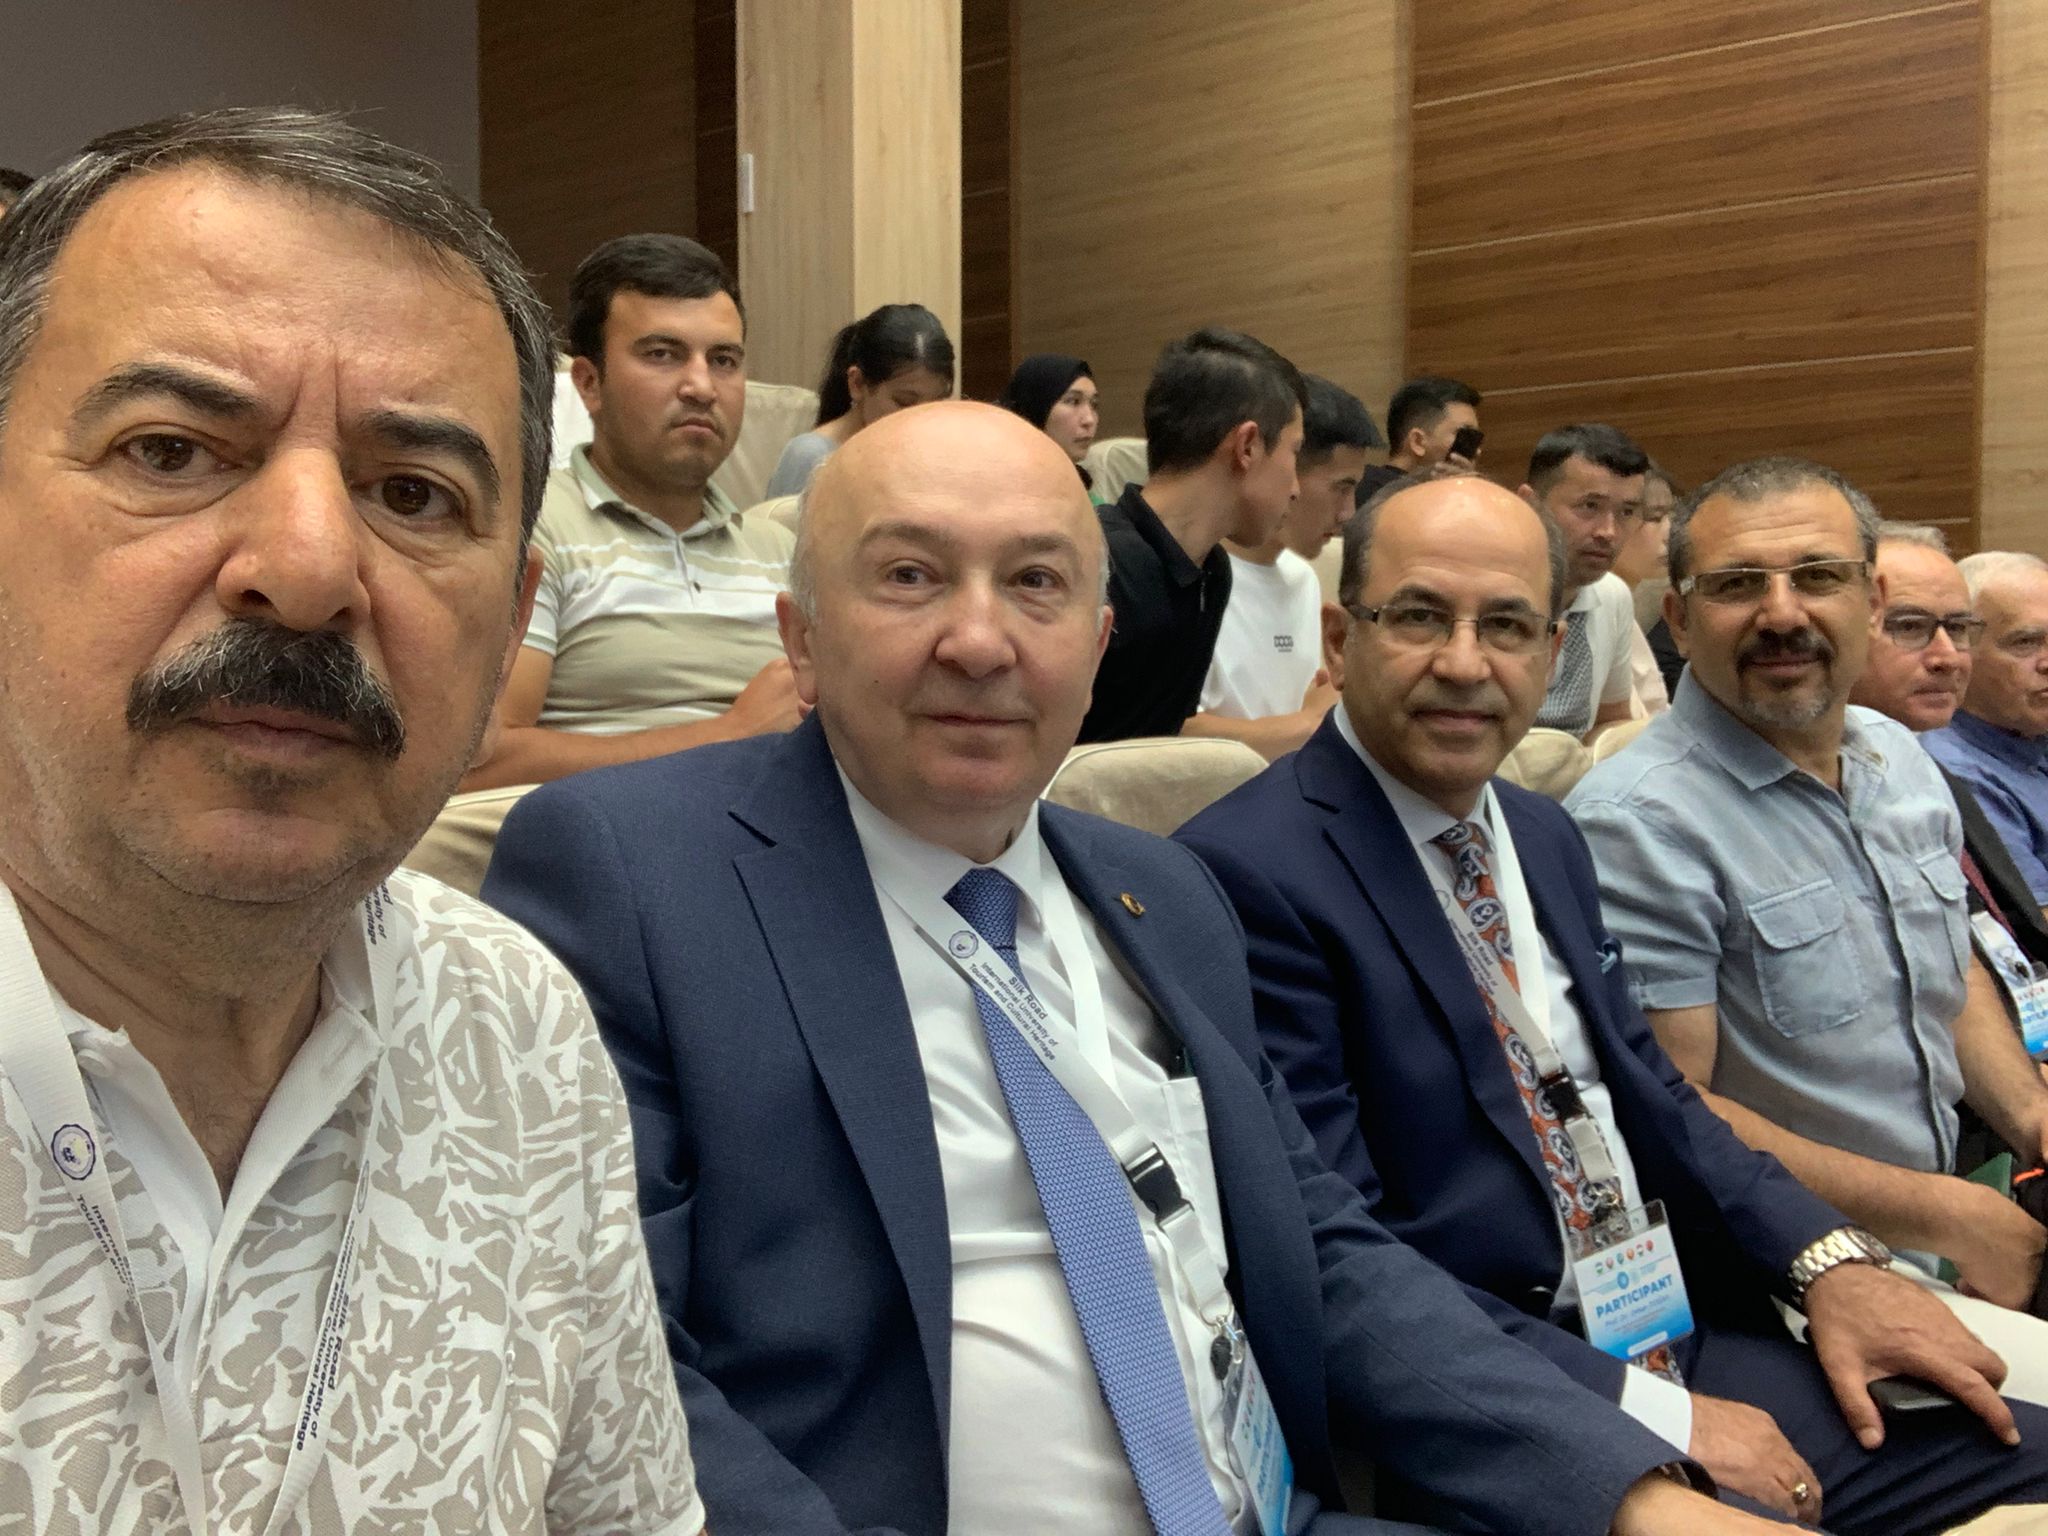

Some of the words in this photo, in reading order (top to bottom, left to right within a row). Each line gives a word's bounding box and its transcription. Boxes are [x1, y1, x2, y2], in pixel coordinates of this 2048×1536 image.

[378, 924, 387, 939] of
[969, 963, 996, 990] Tourism
[994, 989, 1008, 1003] and
[1006, 1002, 1032, 1031] Cultural
[1030, 1030, 1056, 1060] Heritage
[981, 962, 1020, 1004] International
[1019, 1002, 1050, 1039] University
[1048, 1038, 1059, 1047] of
[1008, 976, 1026, 995] Silk
[1024, 994, 1048, 1020] Road
[77, 1194, 110, 1253] Tourism
[329, 1281, 339, 1313] and
[337, 1293, 350, 1330] Silk
[1596, 1274, 1672, 1318] PARTICIPANT
[312, 1315, 331, 1379] Cultural
[328, 1336, 343, 1390] Road
[312, 1336, 335, 1417] University
[297, 1382, 317, 1451] Heritage
[310, 1421, 318, 1439] of
